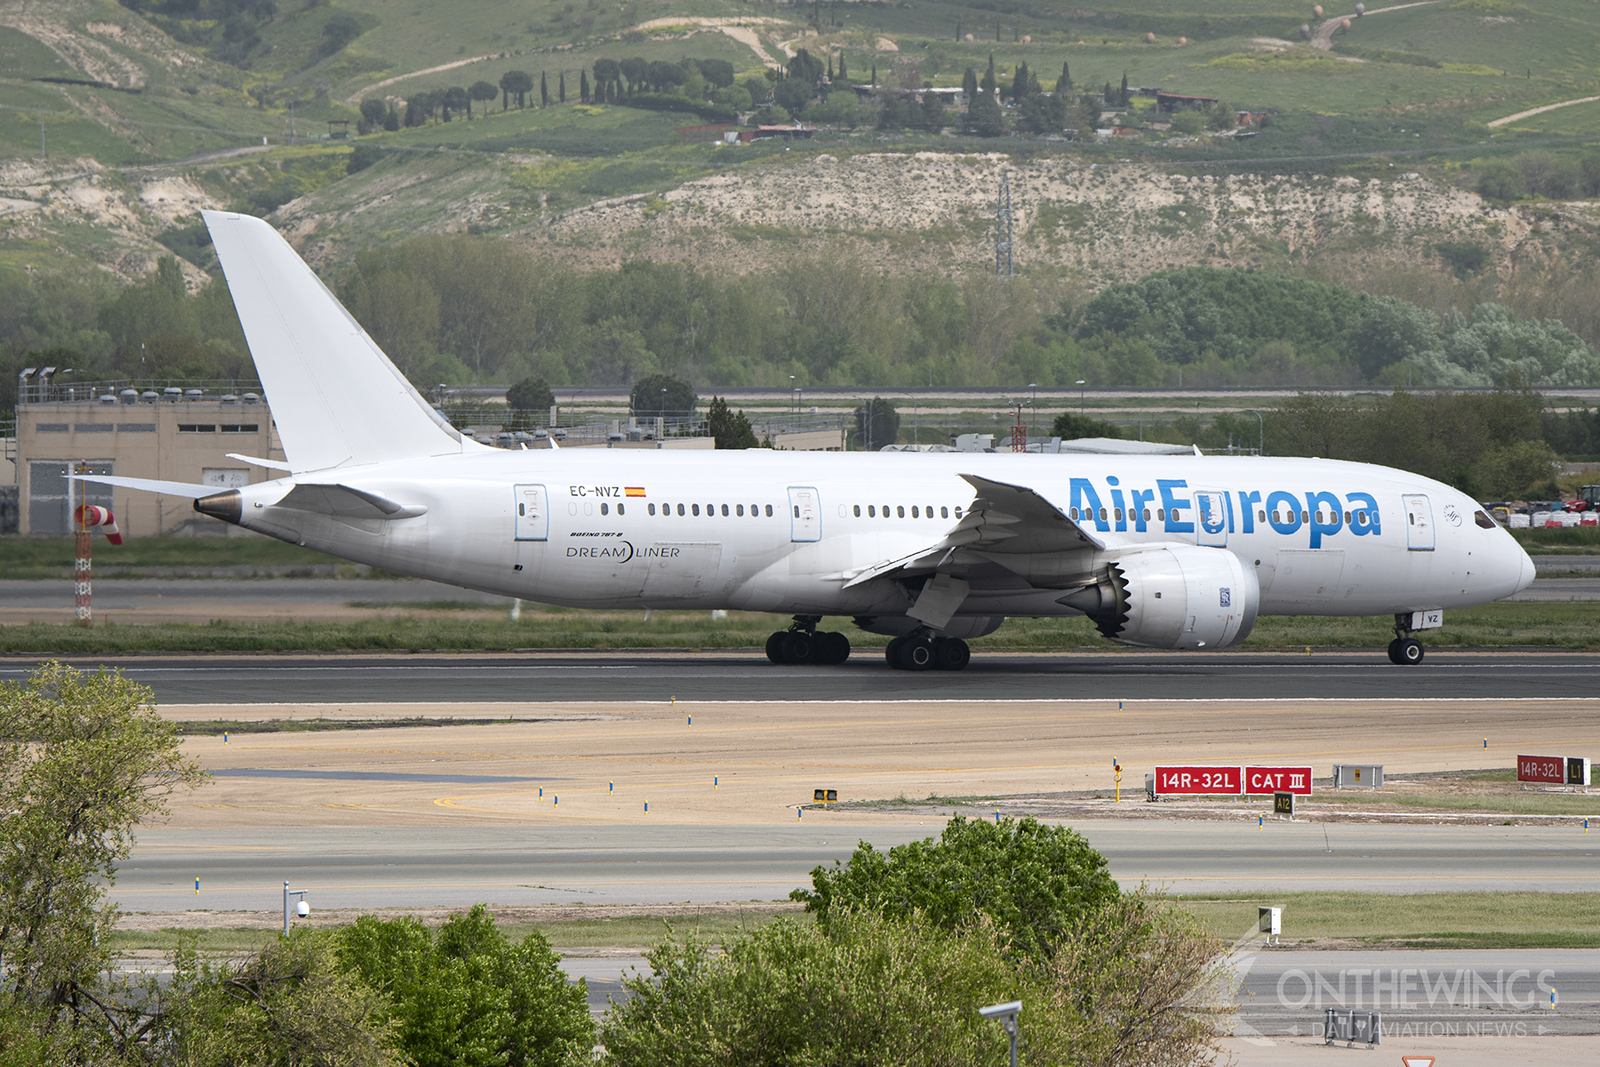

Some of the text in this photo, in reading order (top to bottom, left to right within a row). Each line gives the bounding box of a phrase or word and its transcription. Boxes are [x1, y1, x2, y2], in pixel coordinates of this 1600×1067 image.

[569, 485, 621, 497] EC-NVZ
[1427, 614, 1438, 623] VZ
[1521, 761, 1560, 778] 14R-32L
[1570, 764, 1581, 779] L1
[1162, 773, 1235, 789] 14R-32L
[1251, 773, 1306, 789] CAT III
[1277, 797, 1290, 810] A12
